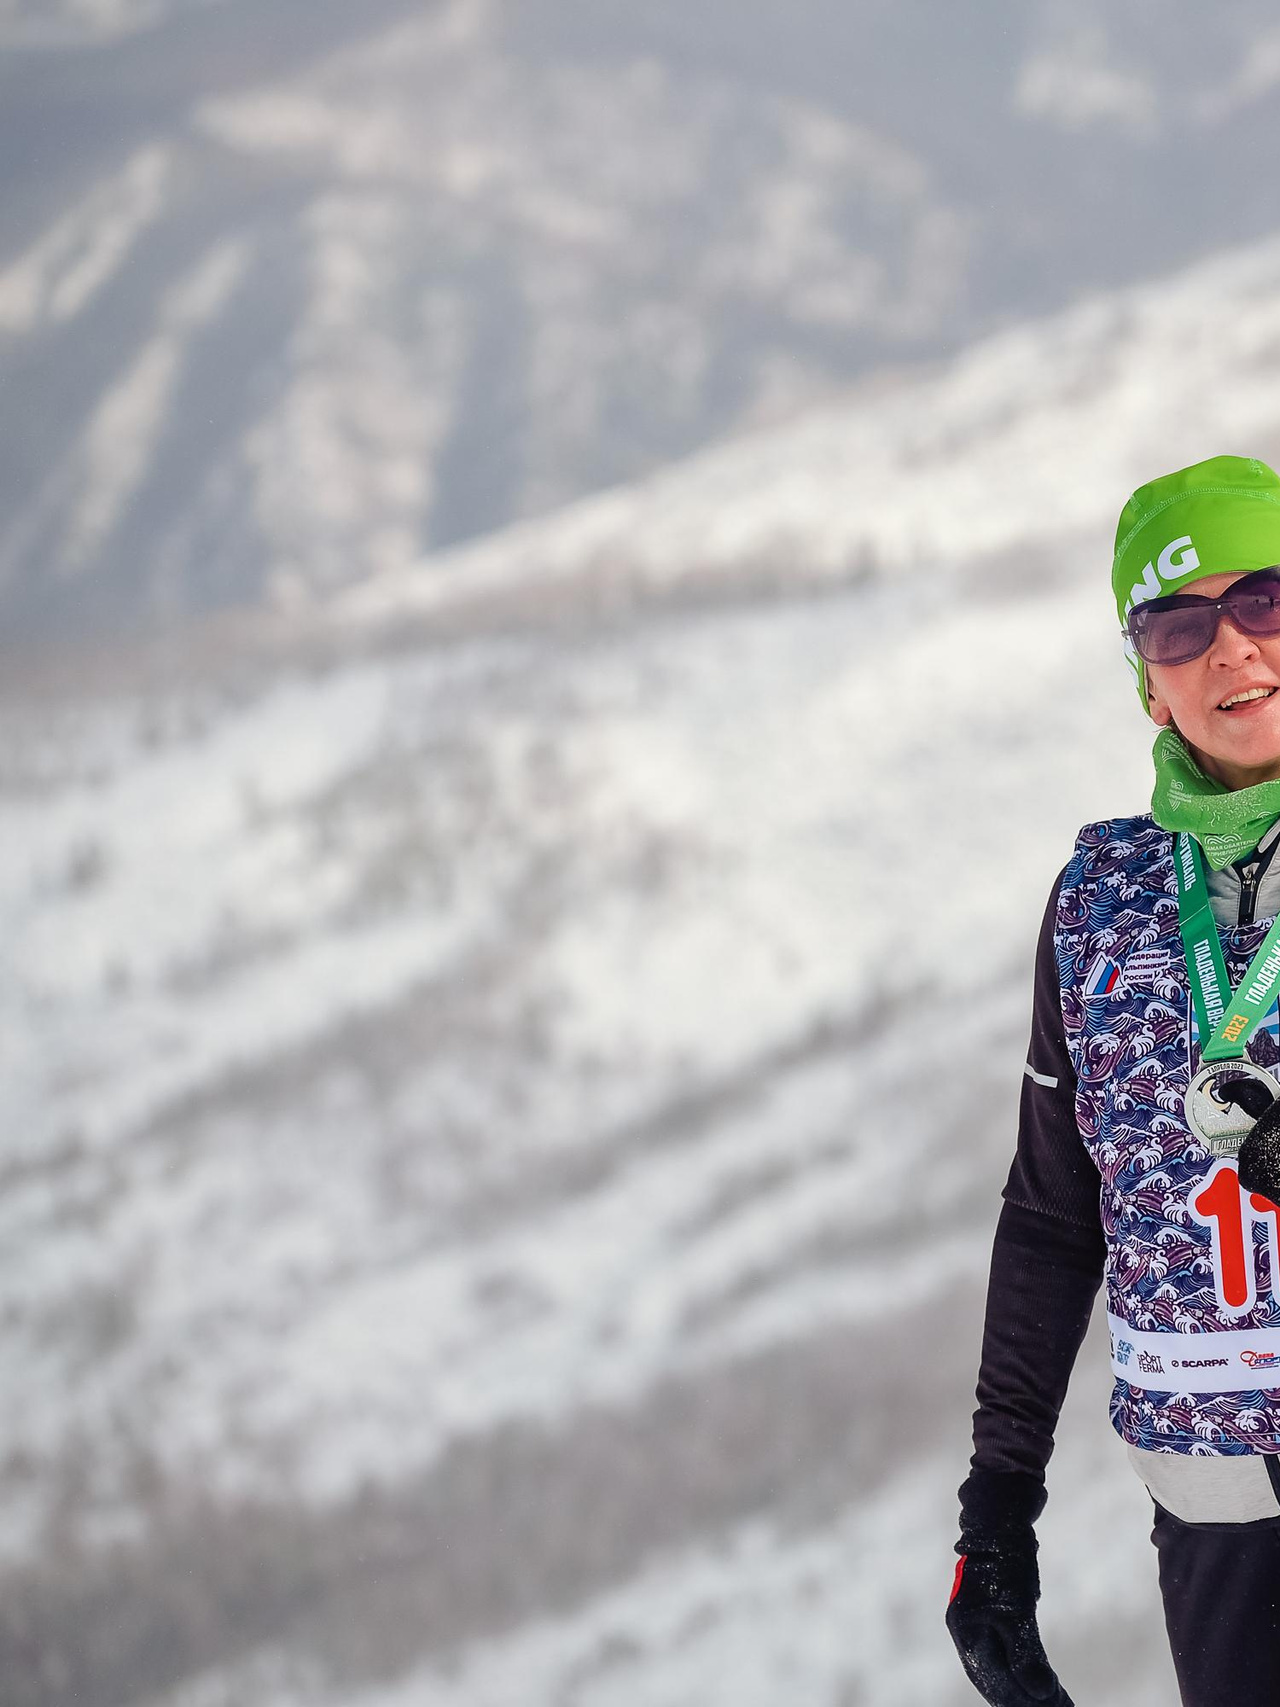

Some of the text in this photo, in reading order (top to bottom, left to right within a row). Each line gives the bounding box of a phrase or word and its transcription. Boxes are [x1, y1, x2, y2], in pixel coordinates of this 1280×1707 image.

[1180, 832, 1197, 891] ЕРТИКАЛЬ
[1193, 939, 1223, 1009] ГЛАДЕНЬКАЯ
[1221, 1014, 1249, 1042] 2023
[1181, 1358, 1228, 1368] SCARPA
